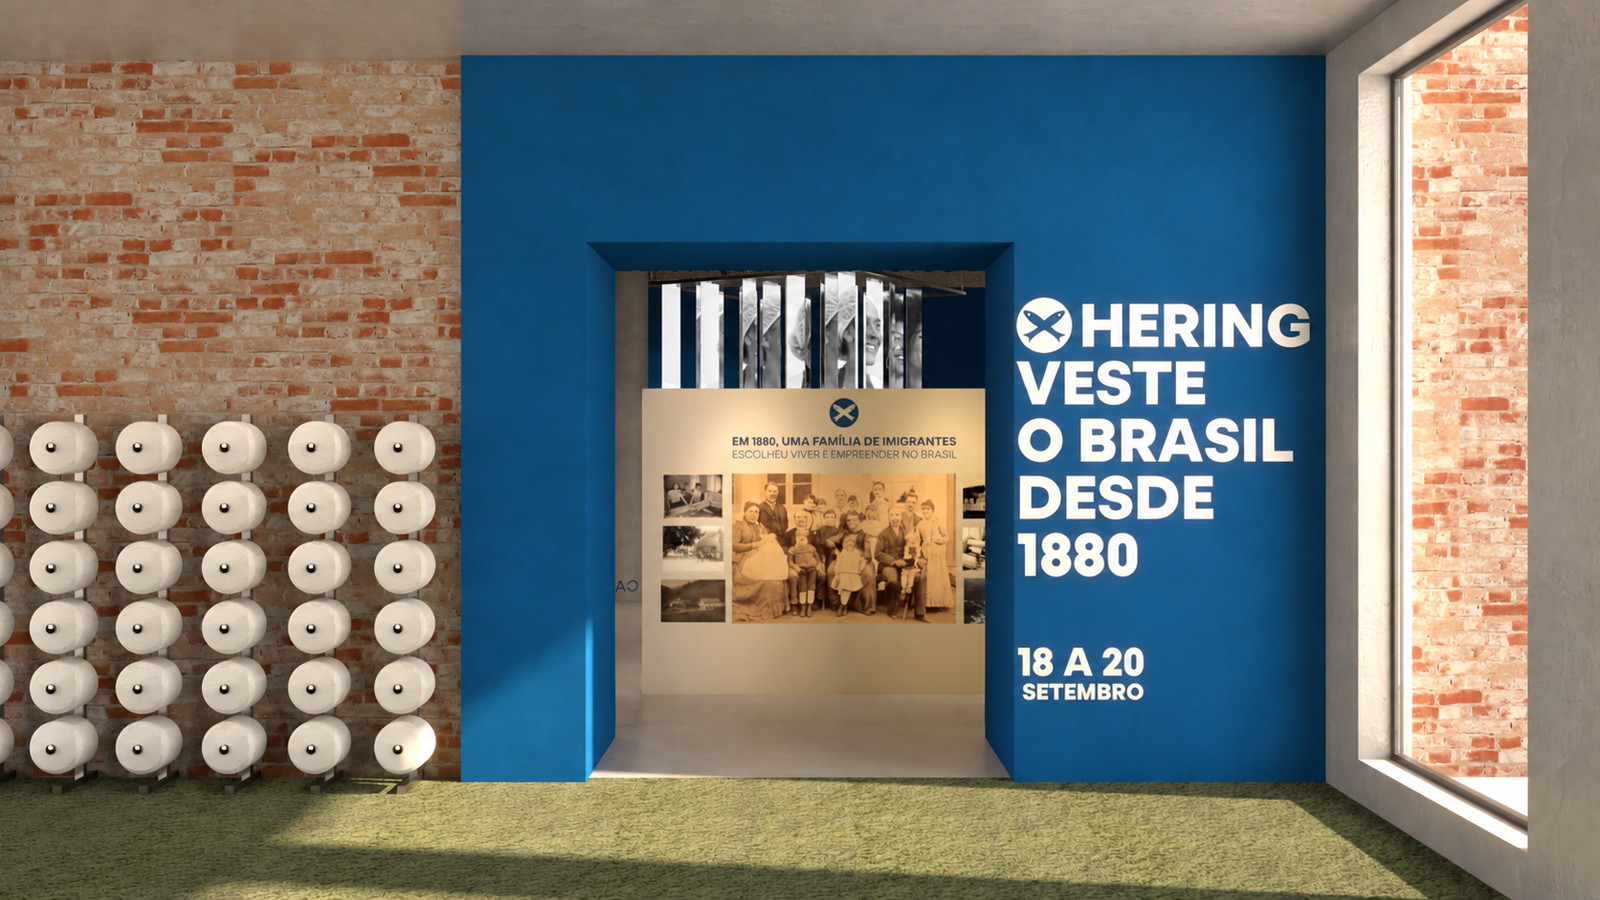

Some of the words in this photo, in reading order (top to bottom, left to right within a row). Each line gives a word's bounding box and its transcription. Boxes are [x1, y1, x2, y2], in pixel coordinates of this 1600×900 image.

[1081, 303, 1311, 348] HERING
[1016, 360, 1206, 406] VESTE
[732, 436, 749, 447] EM
[752, 436, 779, 449] 1880,
[782, 436, 810, 447] UMA
[812, 434, 862, 447] FAMÍLIA
[864, 436, 880, 447] DE
[882, 436, 957, 447] IMIGRANTES
[732, 449, 787, 460] ESCOLHEU
[790, 449, 821, 460] VIVER
[823, 449, 829, 460] E
[830, 449, 900, 460] EMPREENDER
[902, 449, 919, 460] NO
[921, 449, 957, 460] BRASIL
[1017, 417, 1064, 463] O
[1079, 417, 1294, 463] BRASIL
[1019, 475, 1215, 521] DESDE
[1017, 532, 1139, 578] 1880
[1017, 647, 1054, 677] 18
[1063, 647, 1094, 677] A
[1102, 647, 1145, 677] 20
[1022, 683, 1145, 701] SETEMBRO
